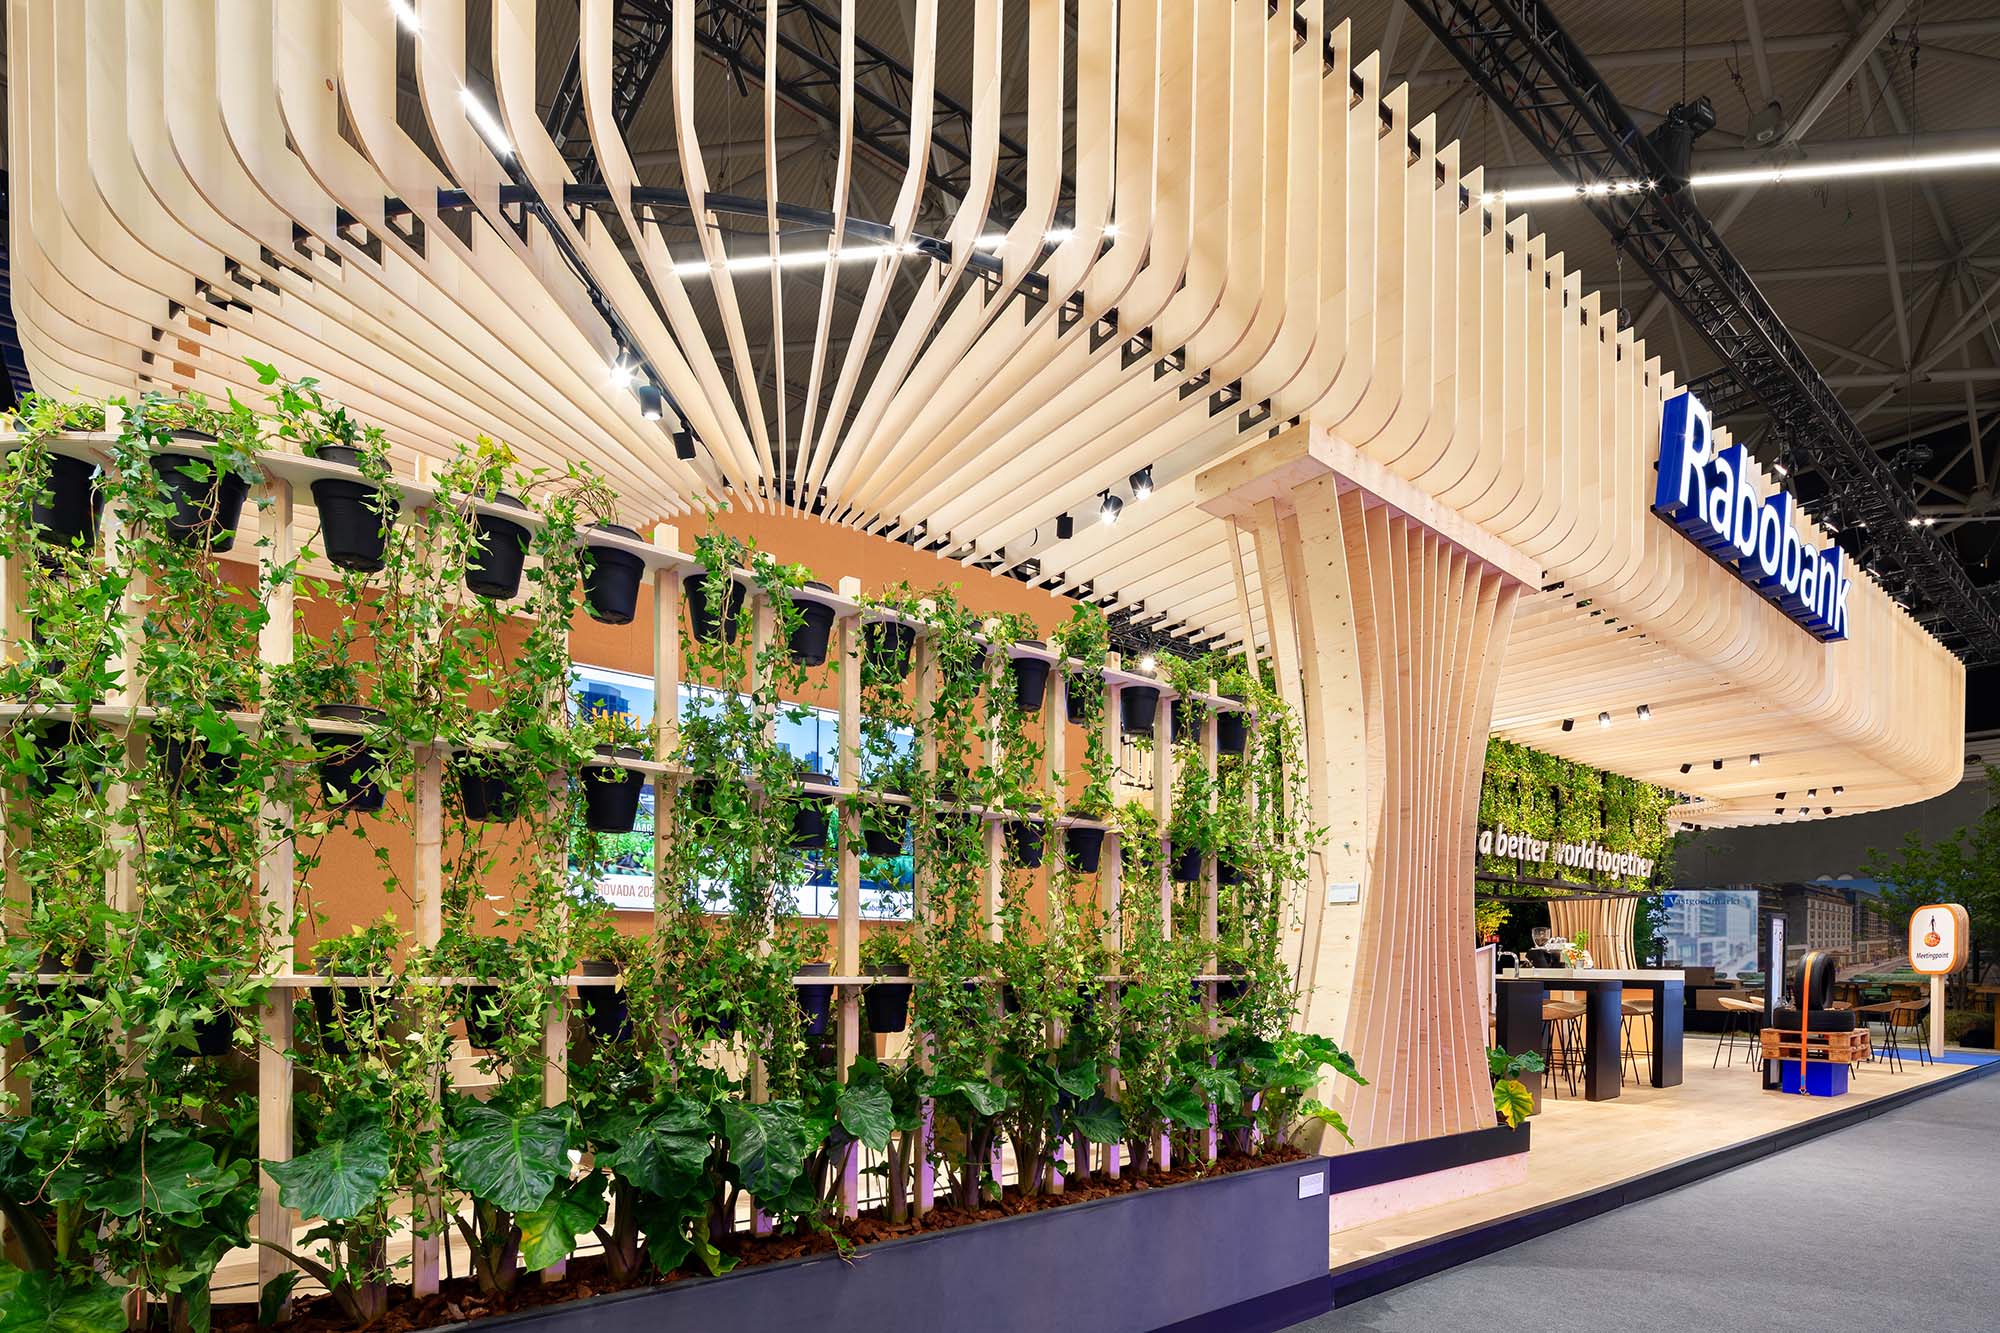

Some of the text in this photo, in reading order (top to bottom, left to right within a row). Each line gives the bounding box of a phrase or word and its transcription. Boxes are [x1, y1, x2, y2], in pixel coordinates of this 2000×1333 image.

[1680, 391, 1852, 640] Rabobank
[1478, 824, 1654, 880] a better world together
[597, 882, 655, 898] ROVADA 202
[1668, 896, 1741, 906] Vastgoedmarkt
[1916, 952, 1949, 960] Meetingpoint
